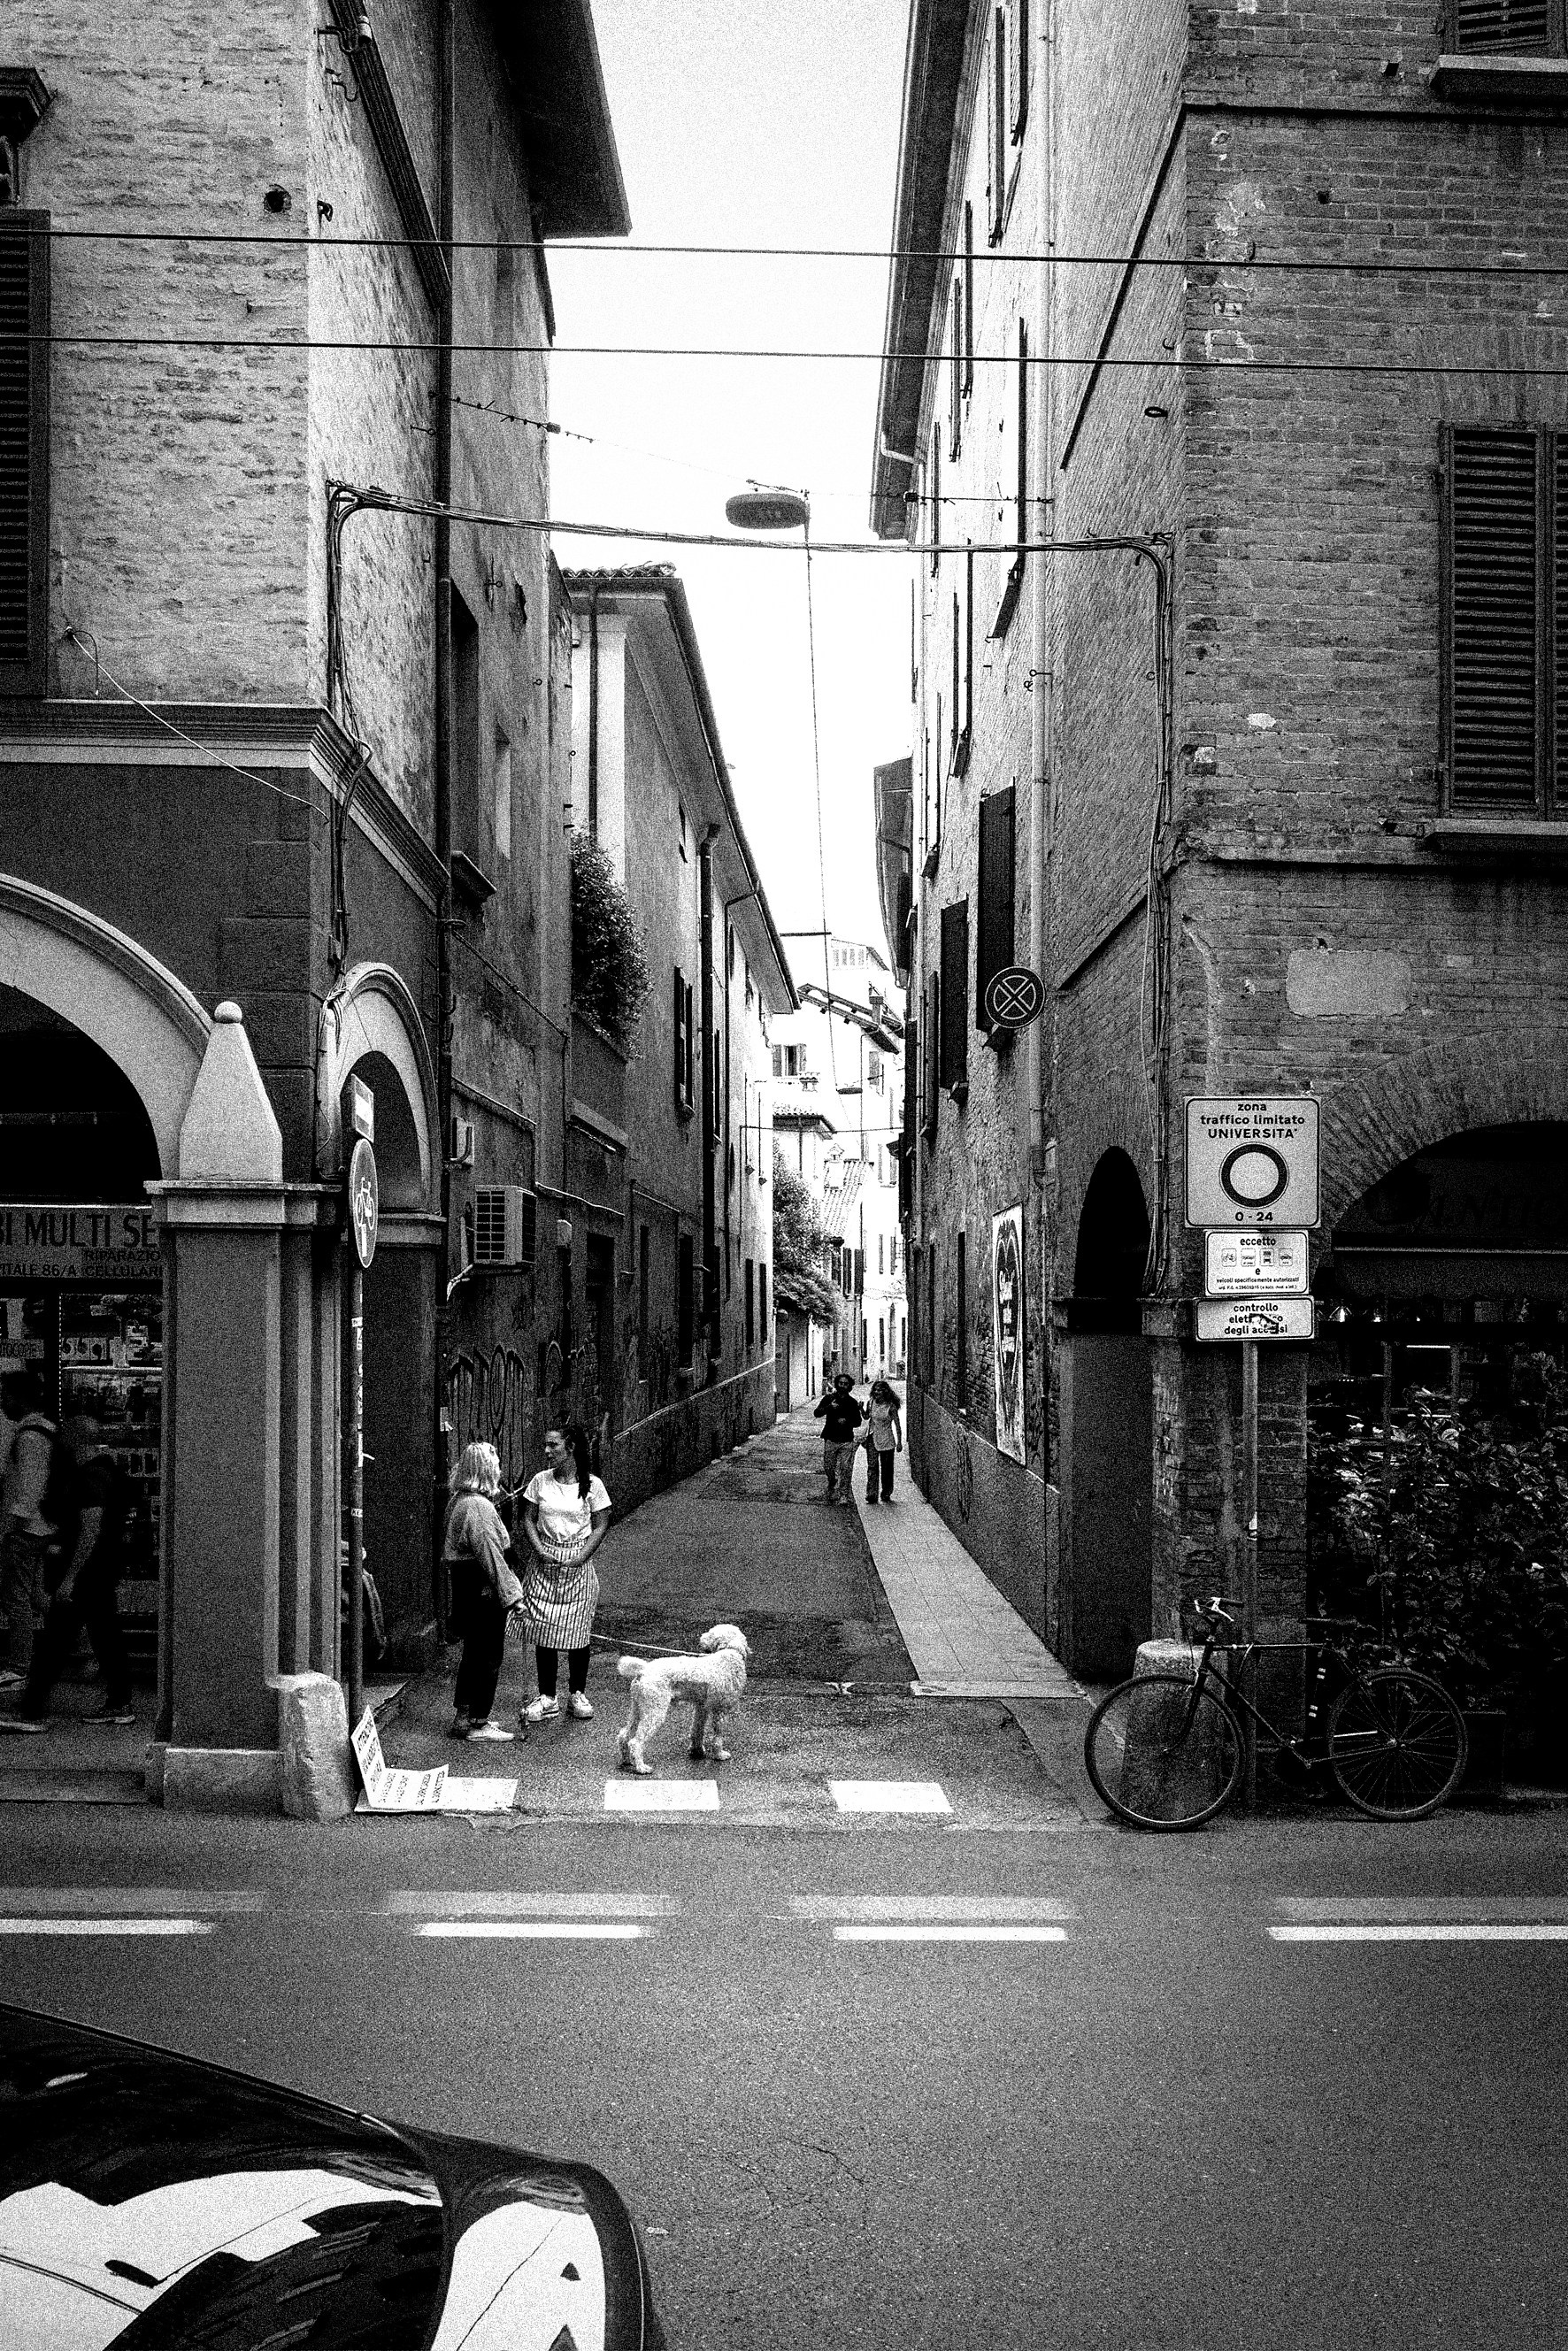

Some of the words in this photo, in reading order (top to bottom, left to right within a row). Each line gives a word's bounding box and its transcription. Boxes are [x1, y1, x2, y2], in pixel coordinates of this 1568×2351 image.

[1237, 1103, 1267, 1112] zona
[1200, 1114, 1250, 1126] traffico
[1253, 1114, 1305, 1126] limitato
[1256, 1211, 1274, 1222] 24
[25, 1212, 111, 1248] MULTI
[1240, 1236, 1276, 1246] eccetto
[42, 1264, 77, 1277] 86/A
[1234, 1302, 1279, 1312] controllo
[1224, 1325, 1249, 1336] degli
